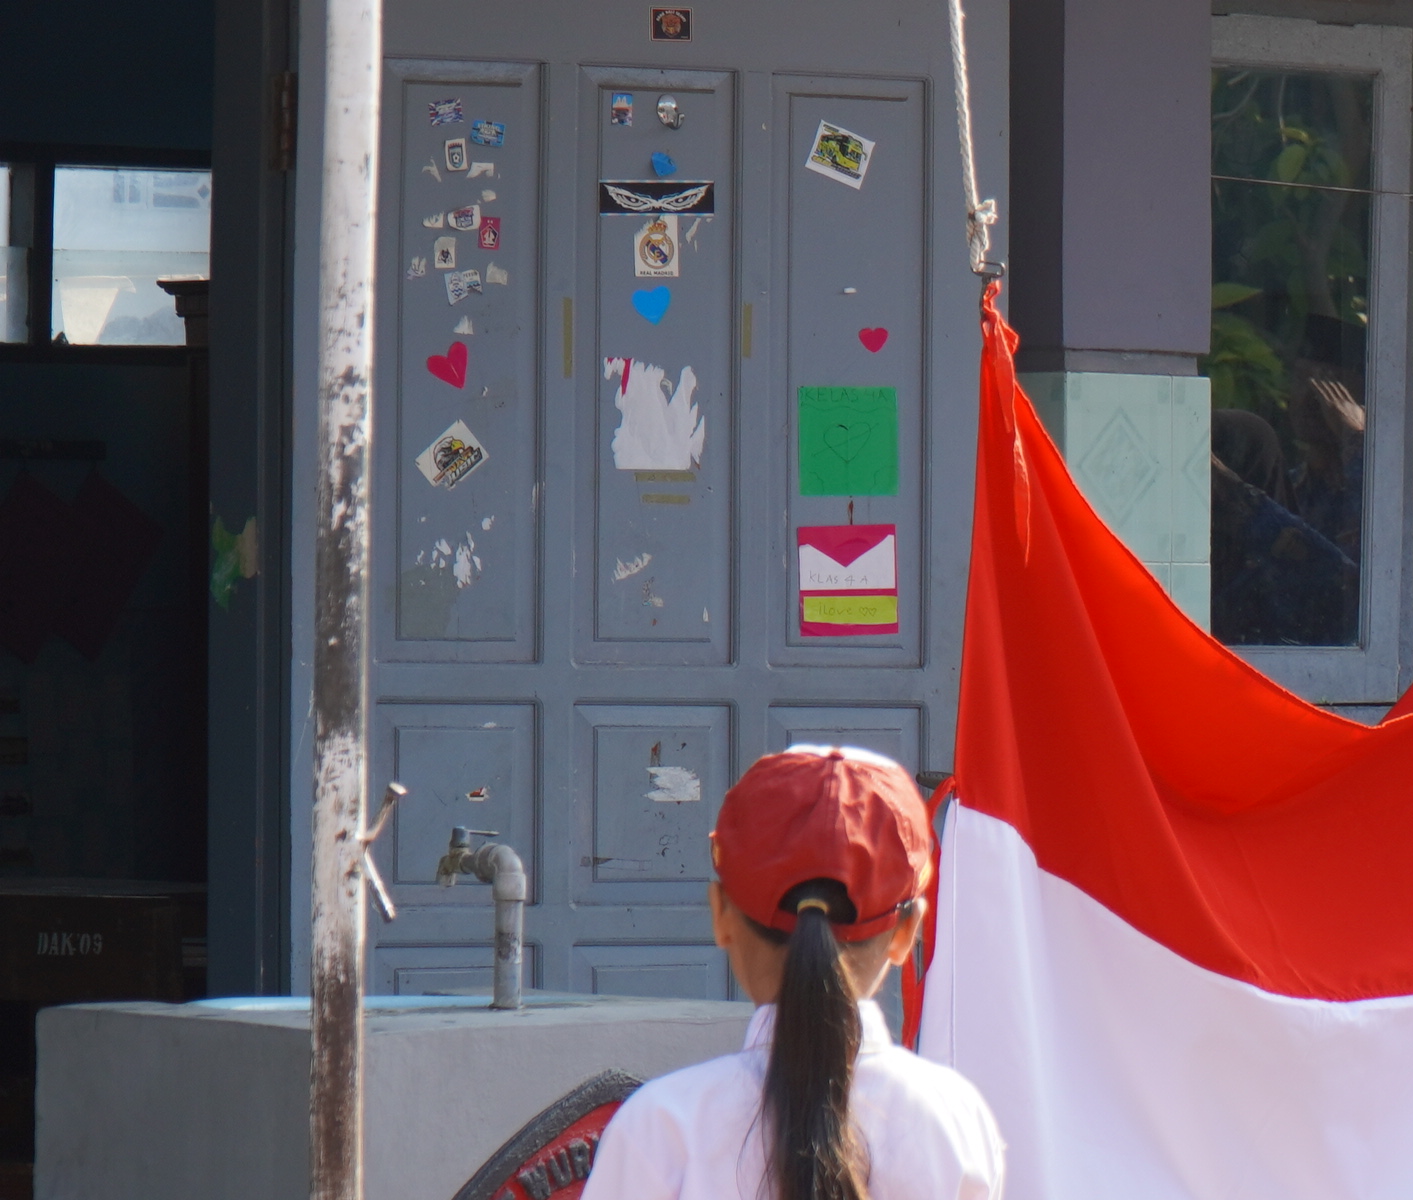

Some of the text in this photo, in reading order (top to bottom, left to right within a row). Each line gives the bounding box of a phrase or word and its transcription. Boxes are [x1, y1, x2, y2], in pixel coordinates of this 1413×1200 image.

[805, 387, 859, 403] KELAS
[809, 570, 868, 586] KLAS 4 A
